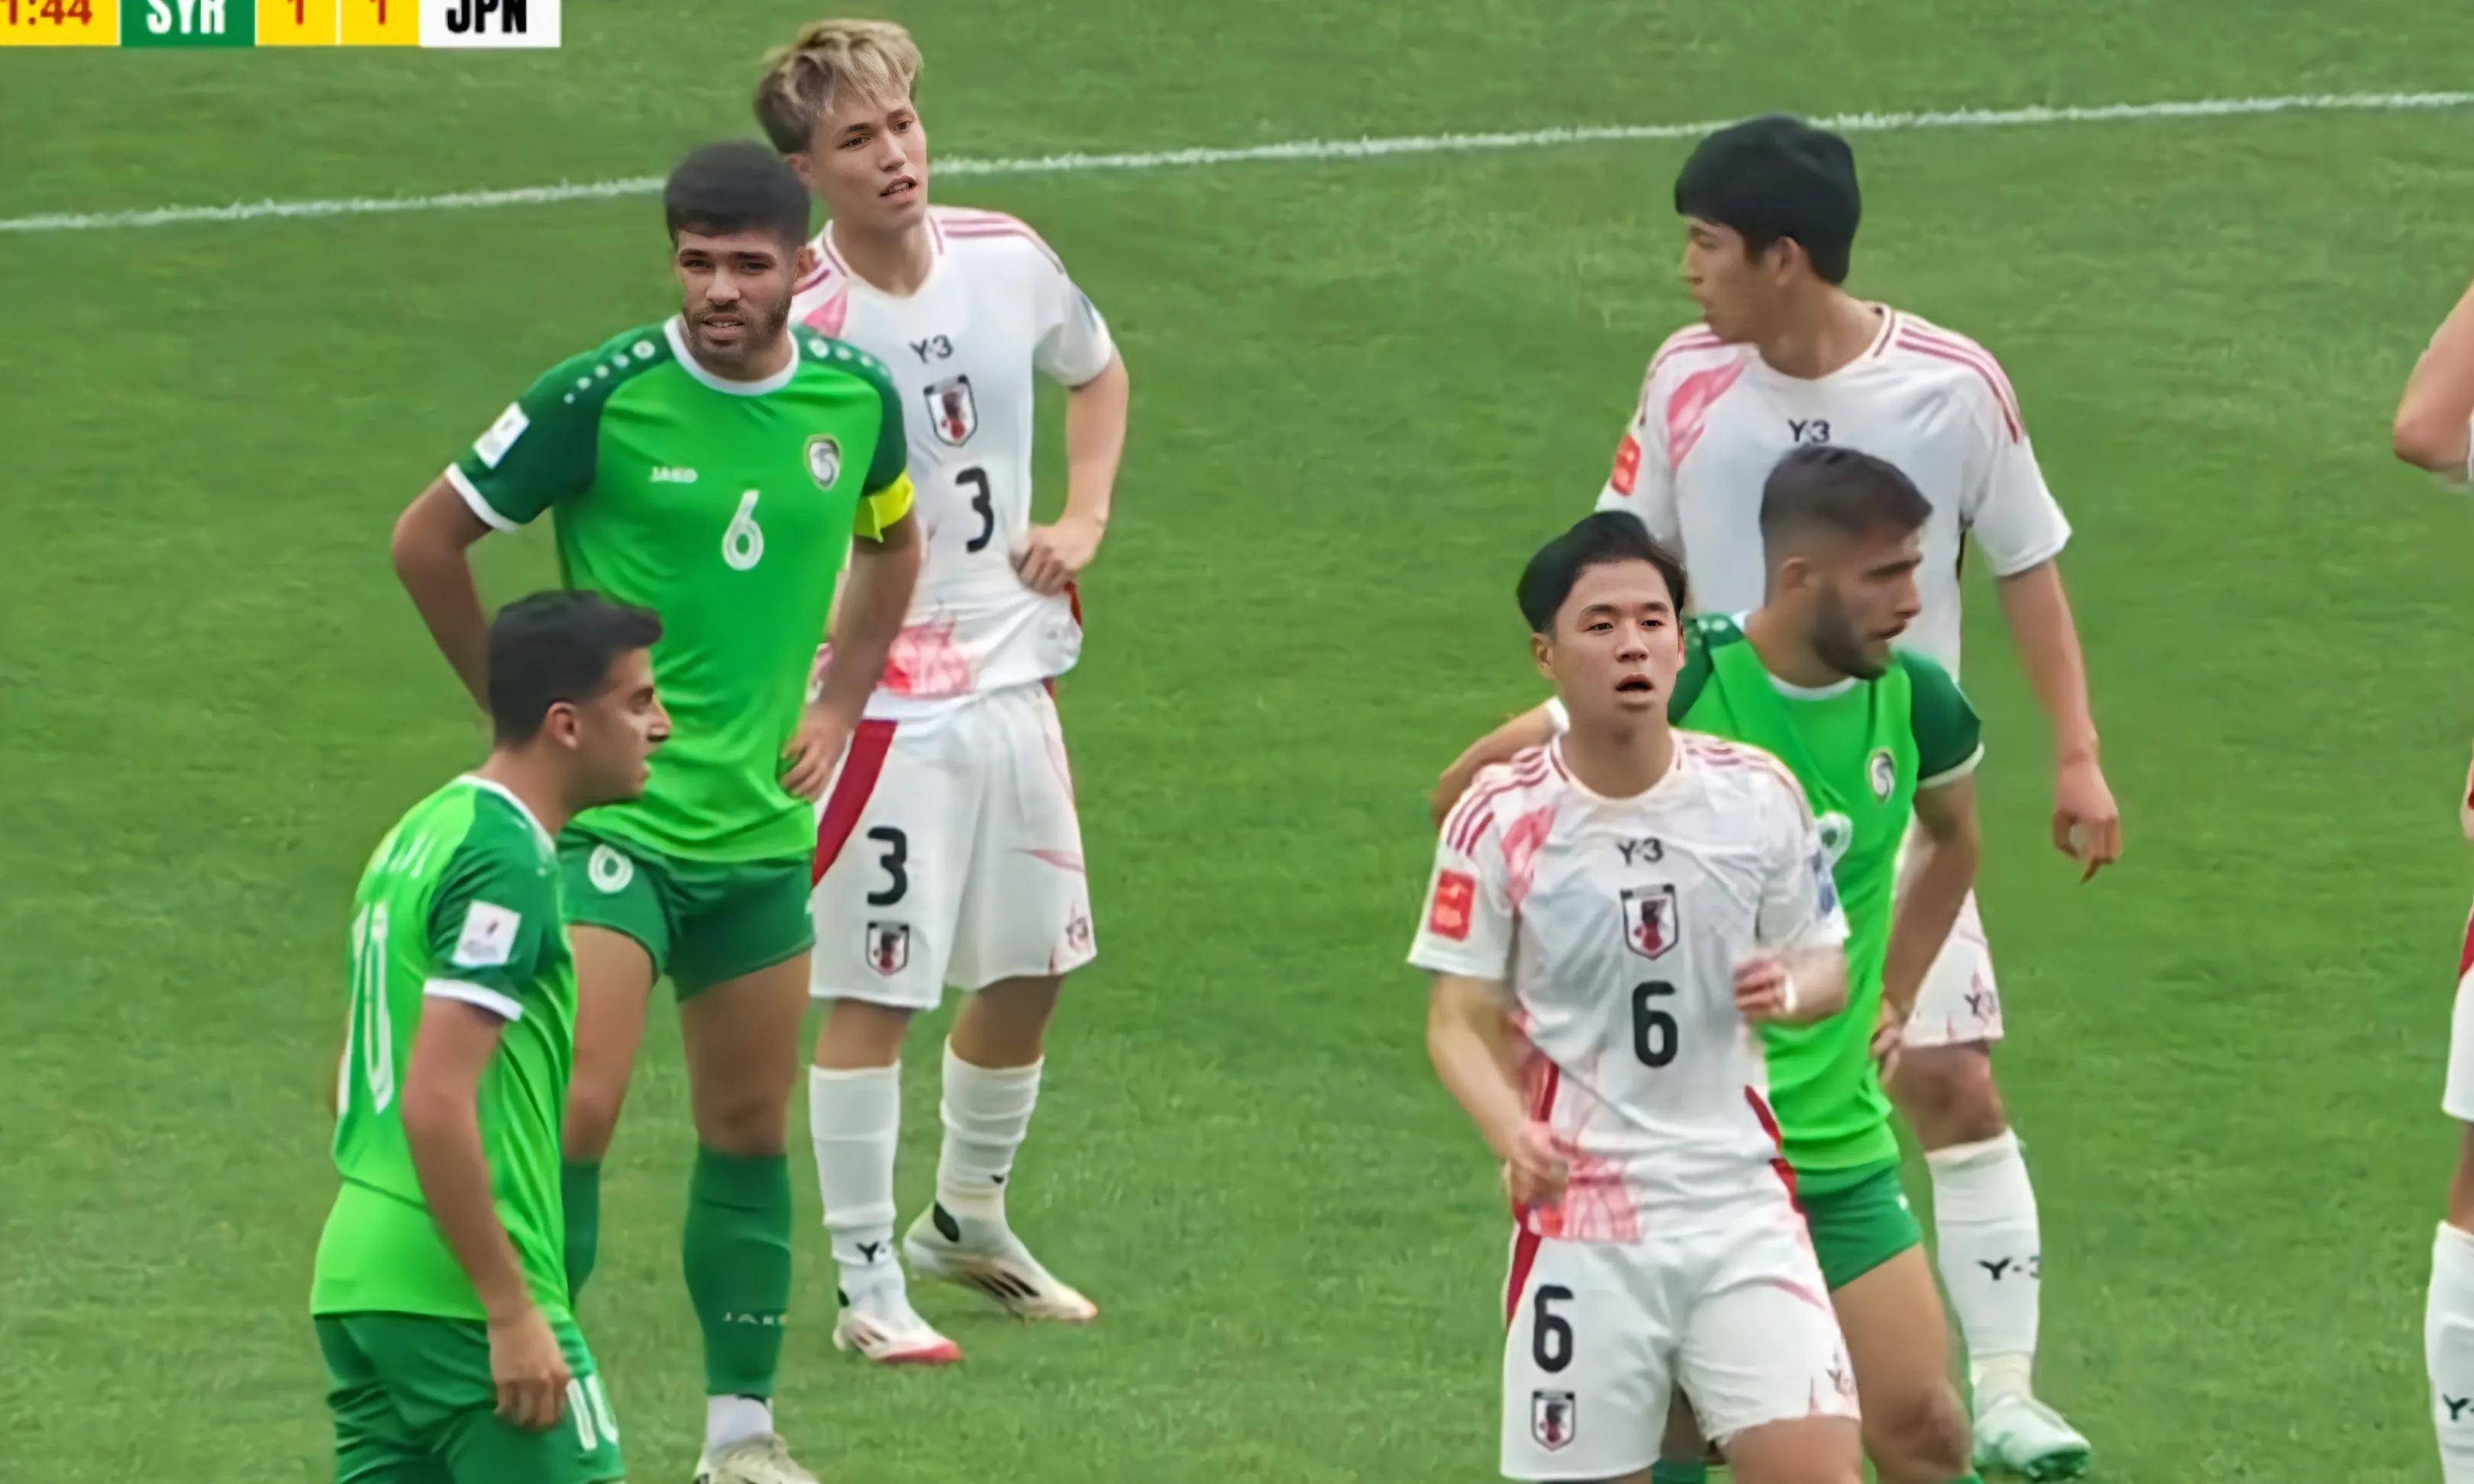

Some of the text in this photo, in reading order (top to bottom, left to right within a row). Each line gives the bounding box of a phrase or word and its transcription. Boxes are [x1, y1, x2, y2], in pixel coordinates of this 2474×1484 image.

[722, 489, 764, 571] 6
[954, 466, 994, 553] 3
[867, 825, 908, 906] 3
[1632, 980, 1678, 1068] 6
[1533, 1284, 1574, 1373] 6
